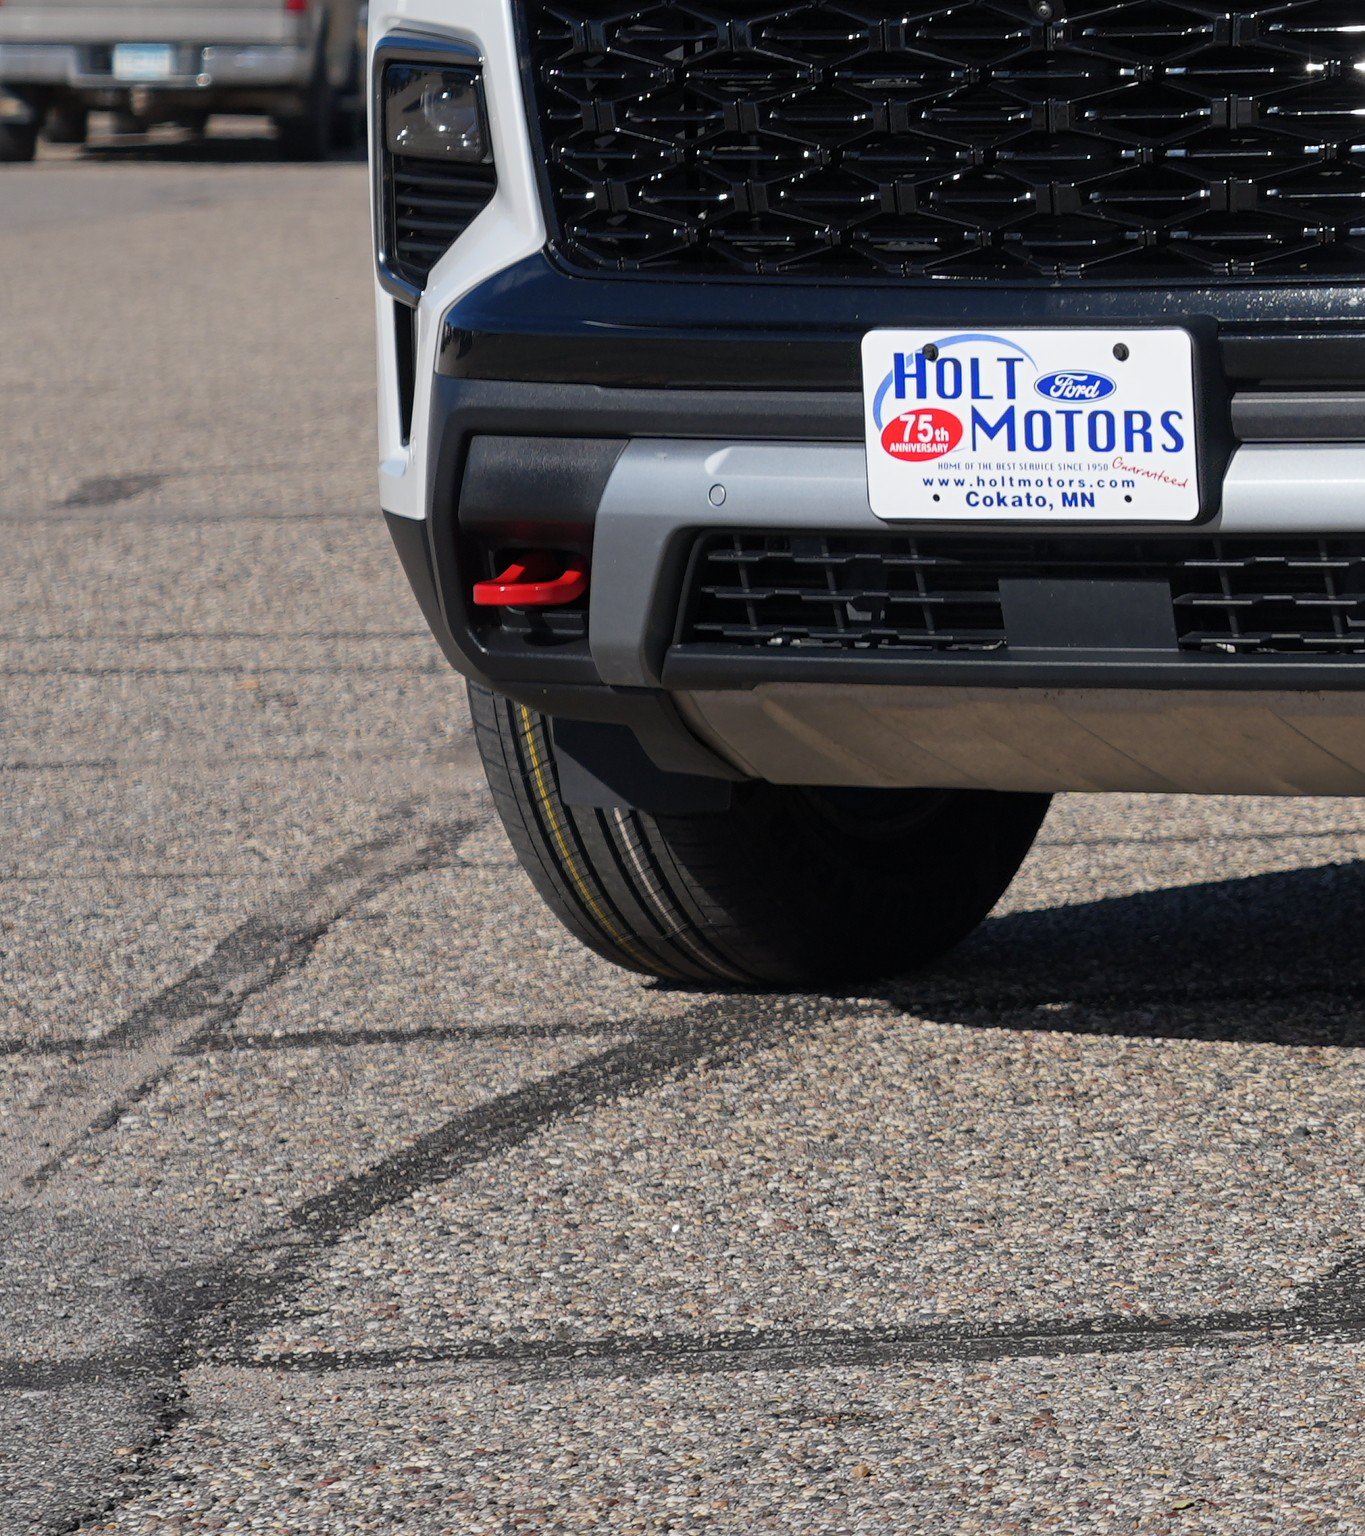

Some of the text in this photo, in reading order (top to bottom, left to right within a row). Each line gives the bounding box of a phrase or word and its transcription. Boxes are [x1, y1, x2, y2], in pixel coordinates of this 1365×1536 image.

[893, 352, 1024, 400] HOLT
[1049, 372, 1100, 399] Ford
[900, 414, 949, 443] 75th
[971, 405, 1185, 453] MOTORS
[889, 442, 949, 453] ANNIVERSARY
[922, 476, 1136, 488] www.holtmotors.com
[937, 456, 1188, 489] HOME OF THE BEST SERVICE SINCE 1950 Guaranteed
[965, 491, 1095, 511] Cokato, MN
